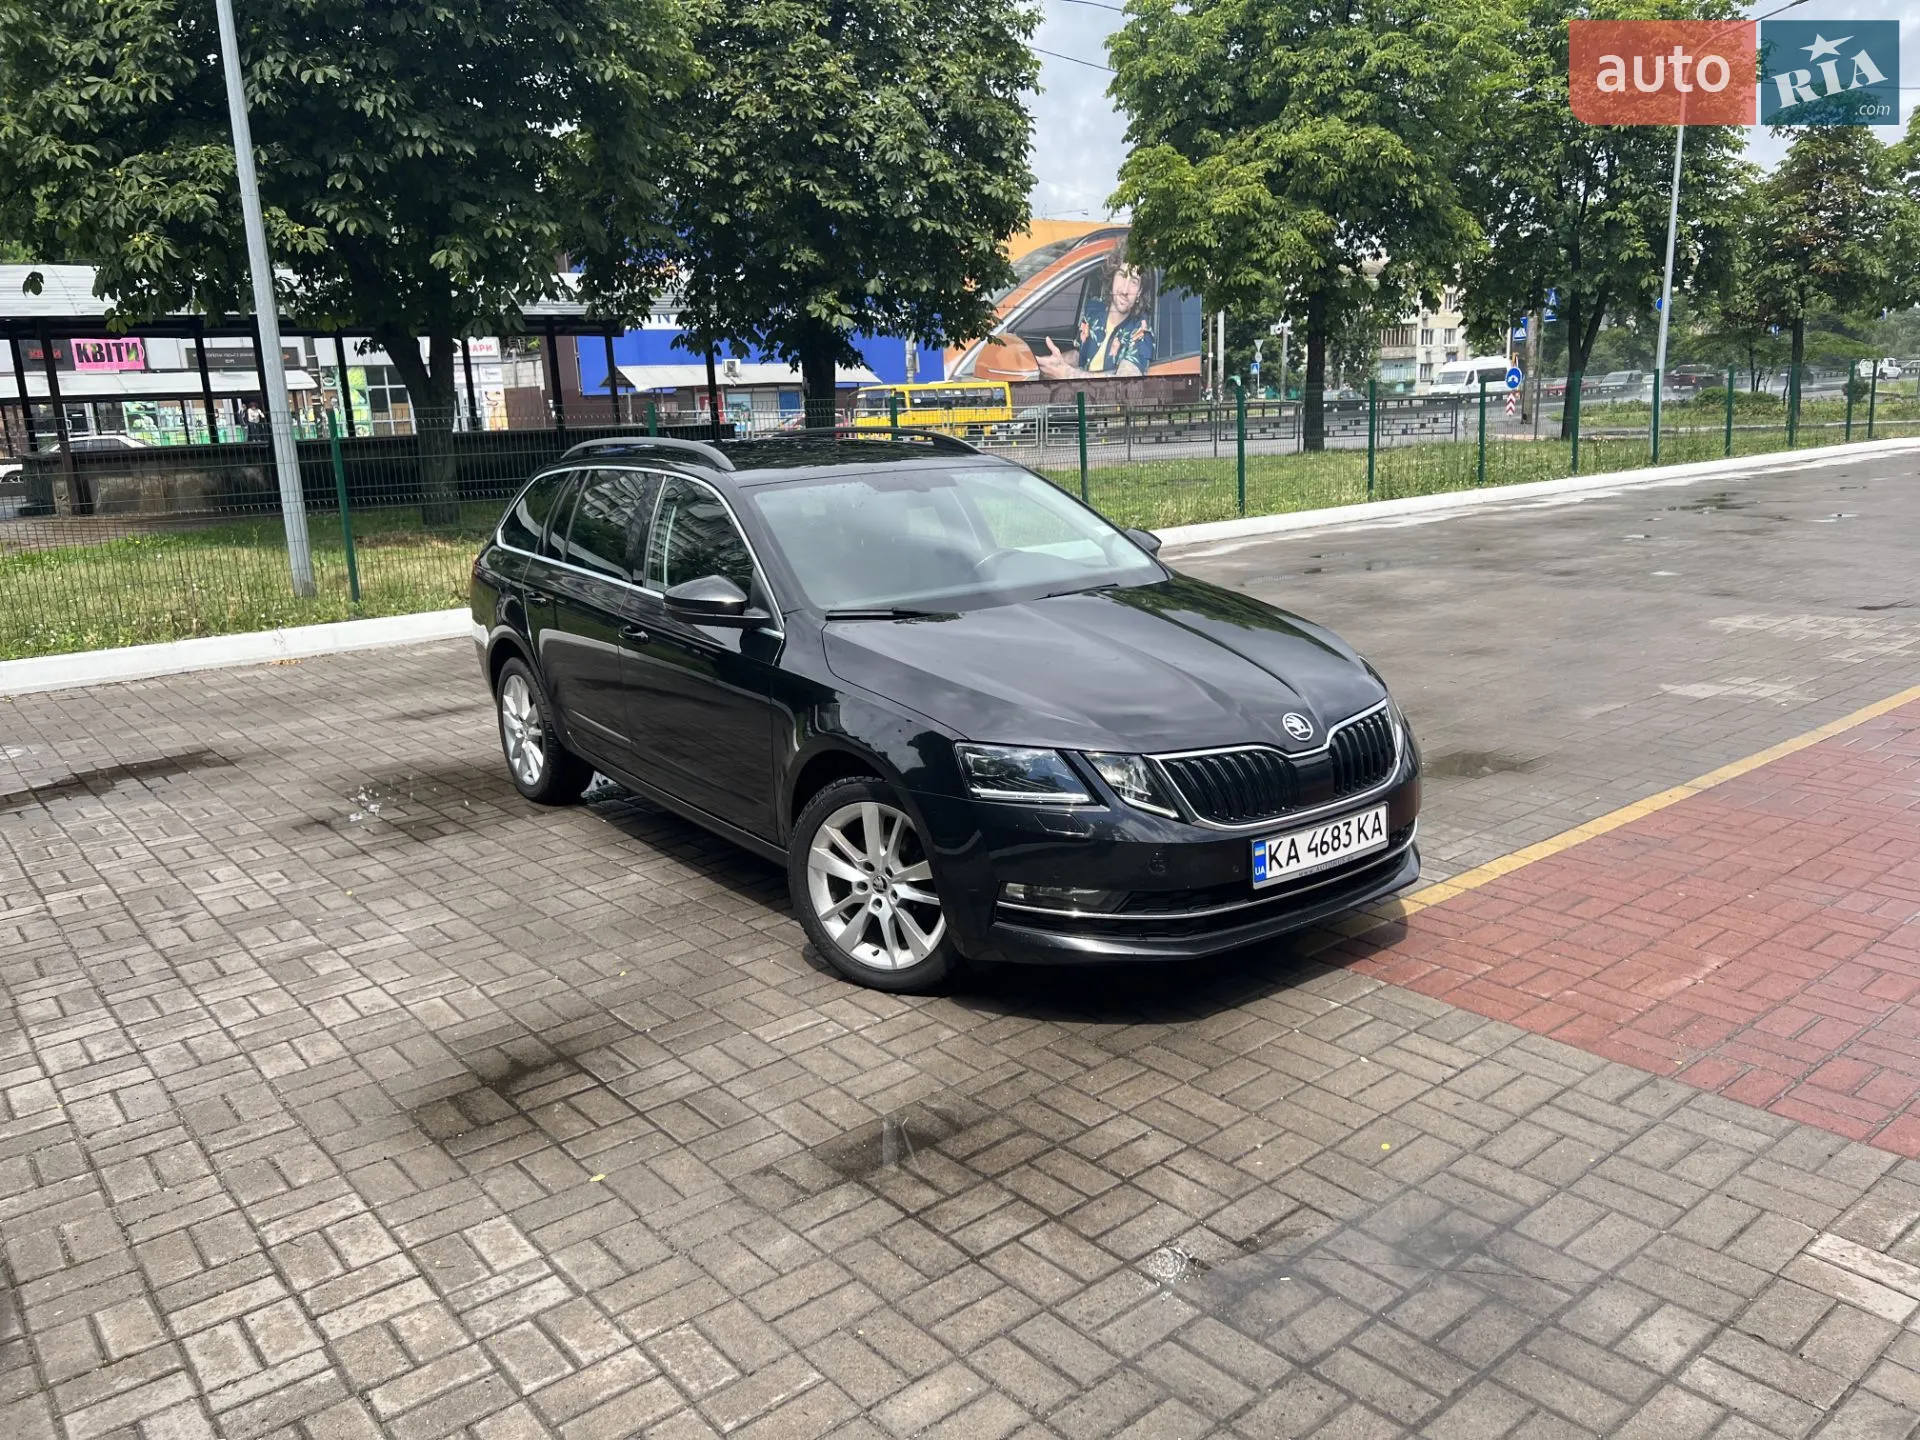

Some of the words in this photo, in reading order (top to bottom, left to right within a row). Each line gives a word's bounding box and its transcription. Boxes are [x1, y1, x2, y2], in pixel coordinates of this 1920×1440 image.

[28, 348, 62, 359] КВИ
[75, 342, 140, 363] КВІТИ
[1268, 837, 1300, 871] KA
[1307, 821, 1351, 858] 4683
[1357, 811, 1383, 844] KA
[1255, 866, 1266, 876] UA
